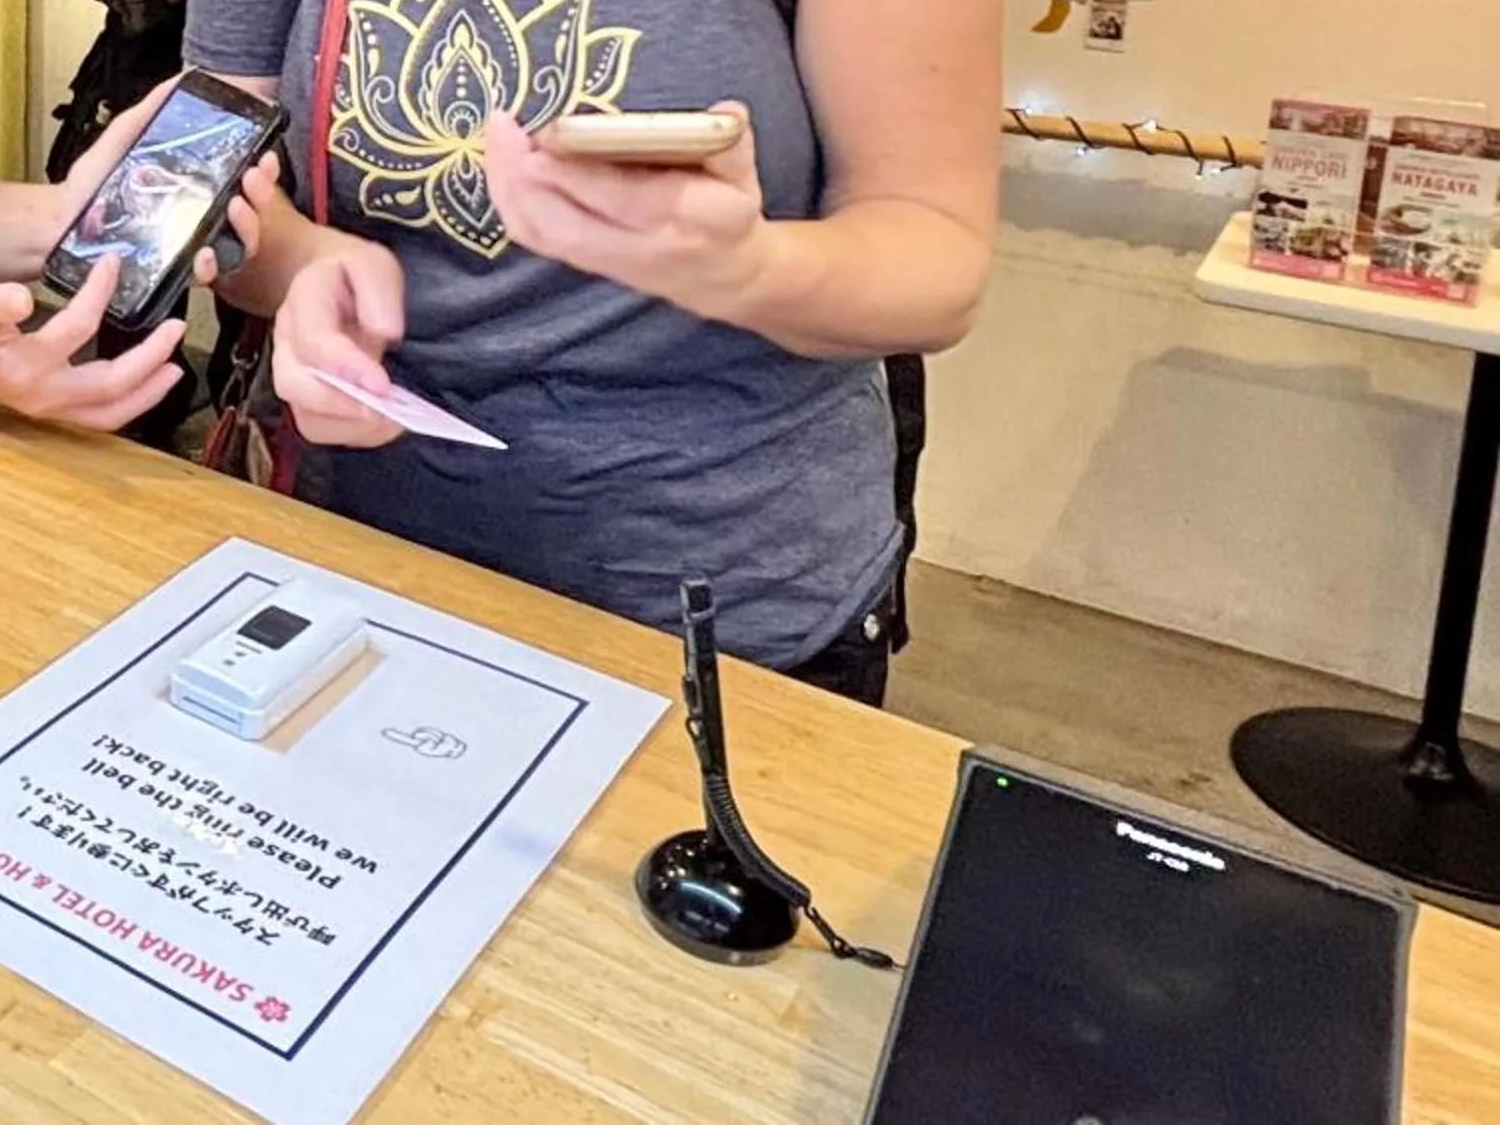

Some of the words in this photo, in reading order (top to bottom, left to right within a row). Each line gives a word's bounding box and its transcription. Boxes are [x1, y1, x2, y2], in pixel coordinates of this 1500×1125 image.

[1270, 152, 1348, 177] NIPPORI
[92, 735, 168, 777] back!
[81, 758, 138, 791] bell
[168, 769, 237, 806] right
[137, 783, 184, 811] the
[184, 804, 246, 839] ring
[238, 803, 275, 828] be
[273, 819, 330, 852] will
[247, 836, 343, 890] Please
[334, 847, 378, 875] we
[32, 873, 53, 891] &
[51, 884, 138, 940] HOTEL
[138, 931, 255, 1002] SAKURA
